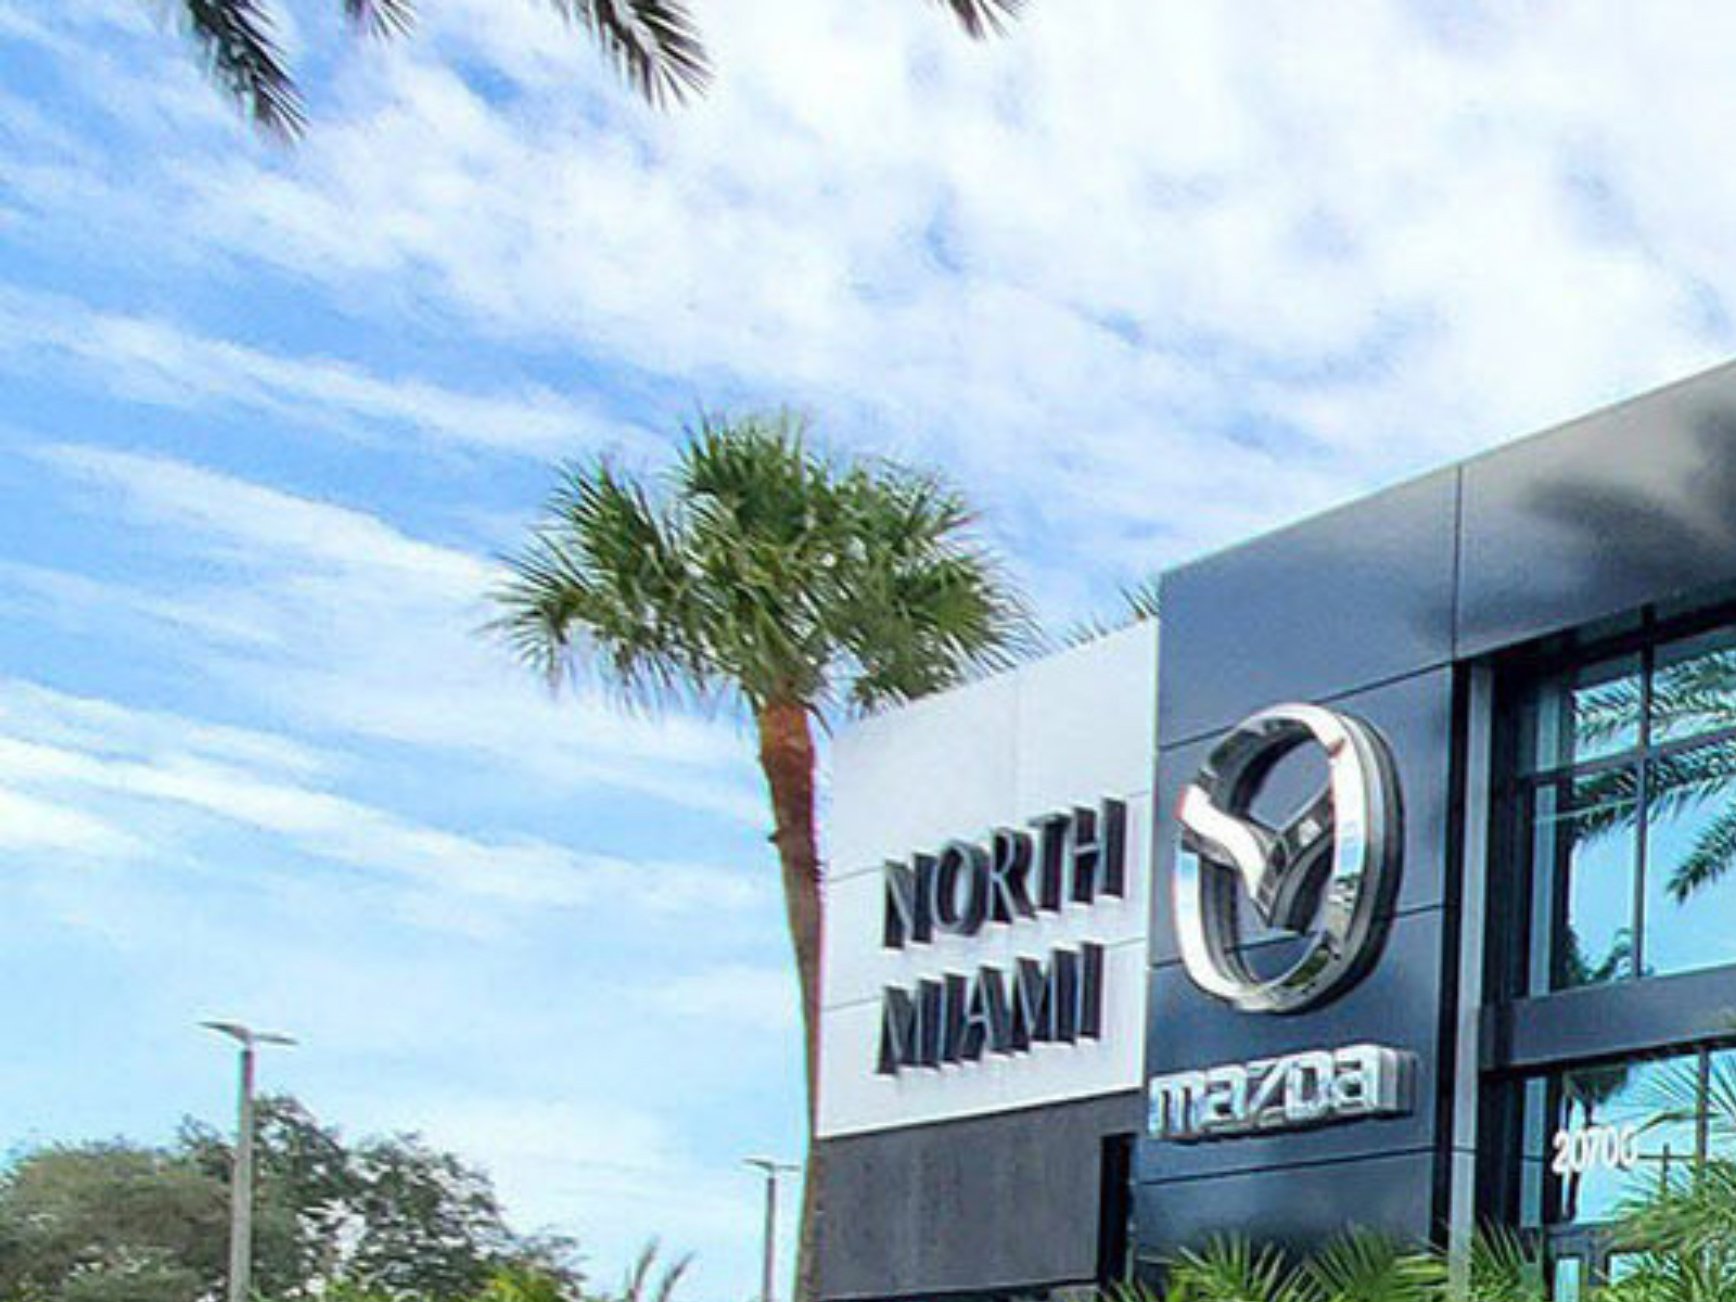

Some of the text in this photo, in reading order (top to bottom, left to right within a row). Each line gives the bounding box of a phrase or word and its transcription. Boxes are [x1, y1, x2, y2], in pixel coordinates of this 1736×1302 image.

[884, 797, 1126, 950] NORTH
[876, 941, 1104, 1075] MIAMI
[1148, 1044, 1397, 1138] mazda
